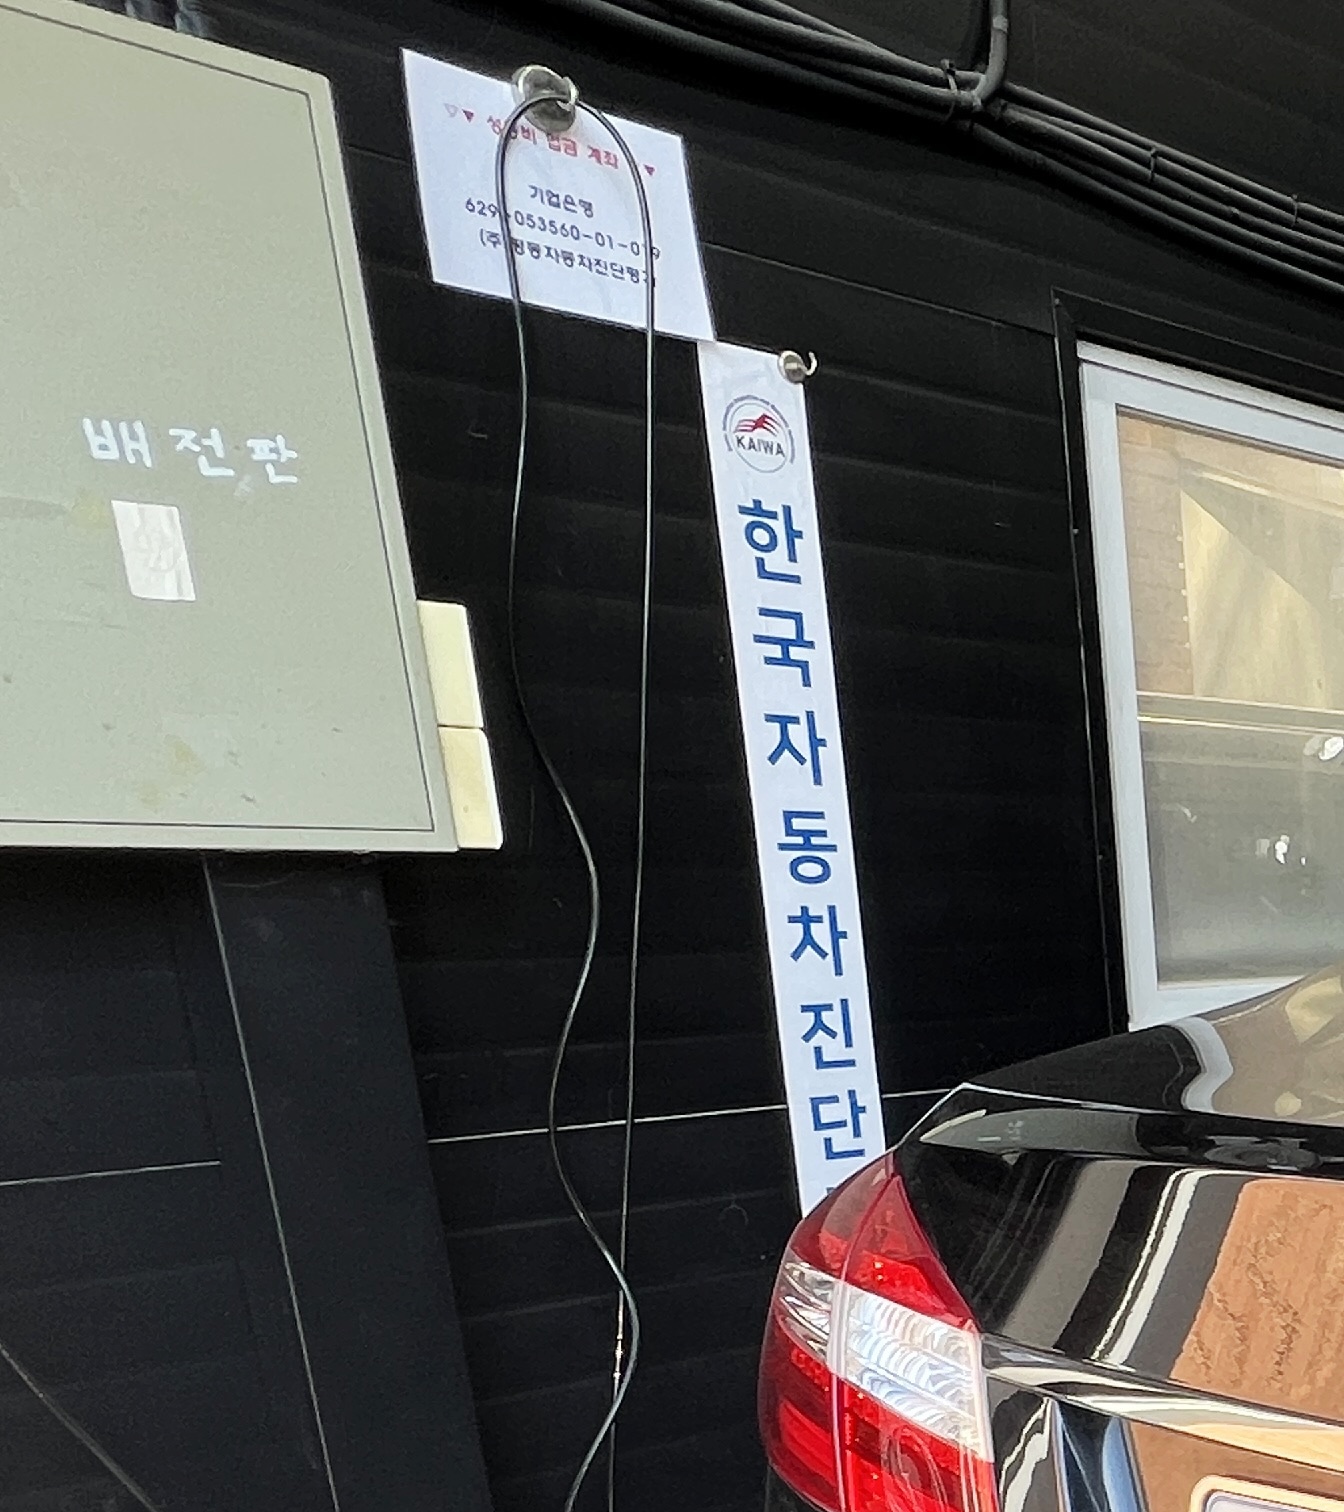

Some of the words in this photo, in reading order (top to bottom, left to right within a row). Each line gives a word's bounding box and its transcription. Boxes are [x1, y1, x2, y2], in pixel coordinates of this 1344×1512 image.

[529, 184, 595, 219] 기업은행
[735, 434, 787, 458] KAIWA
[737, 498, 867, 1196] 한국자동차진단
